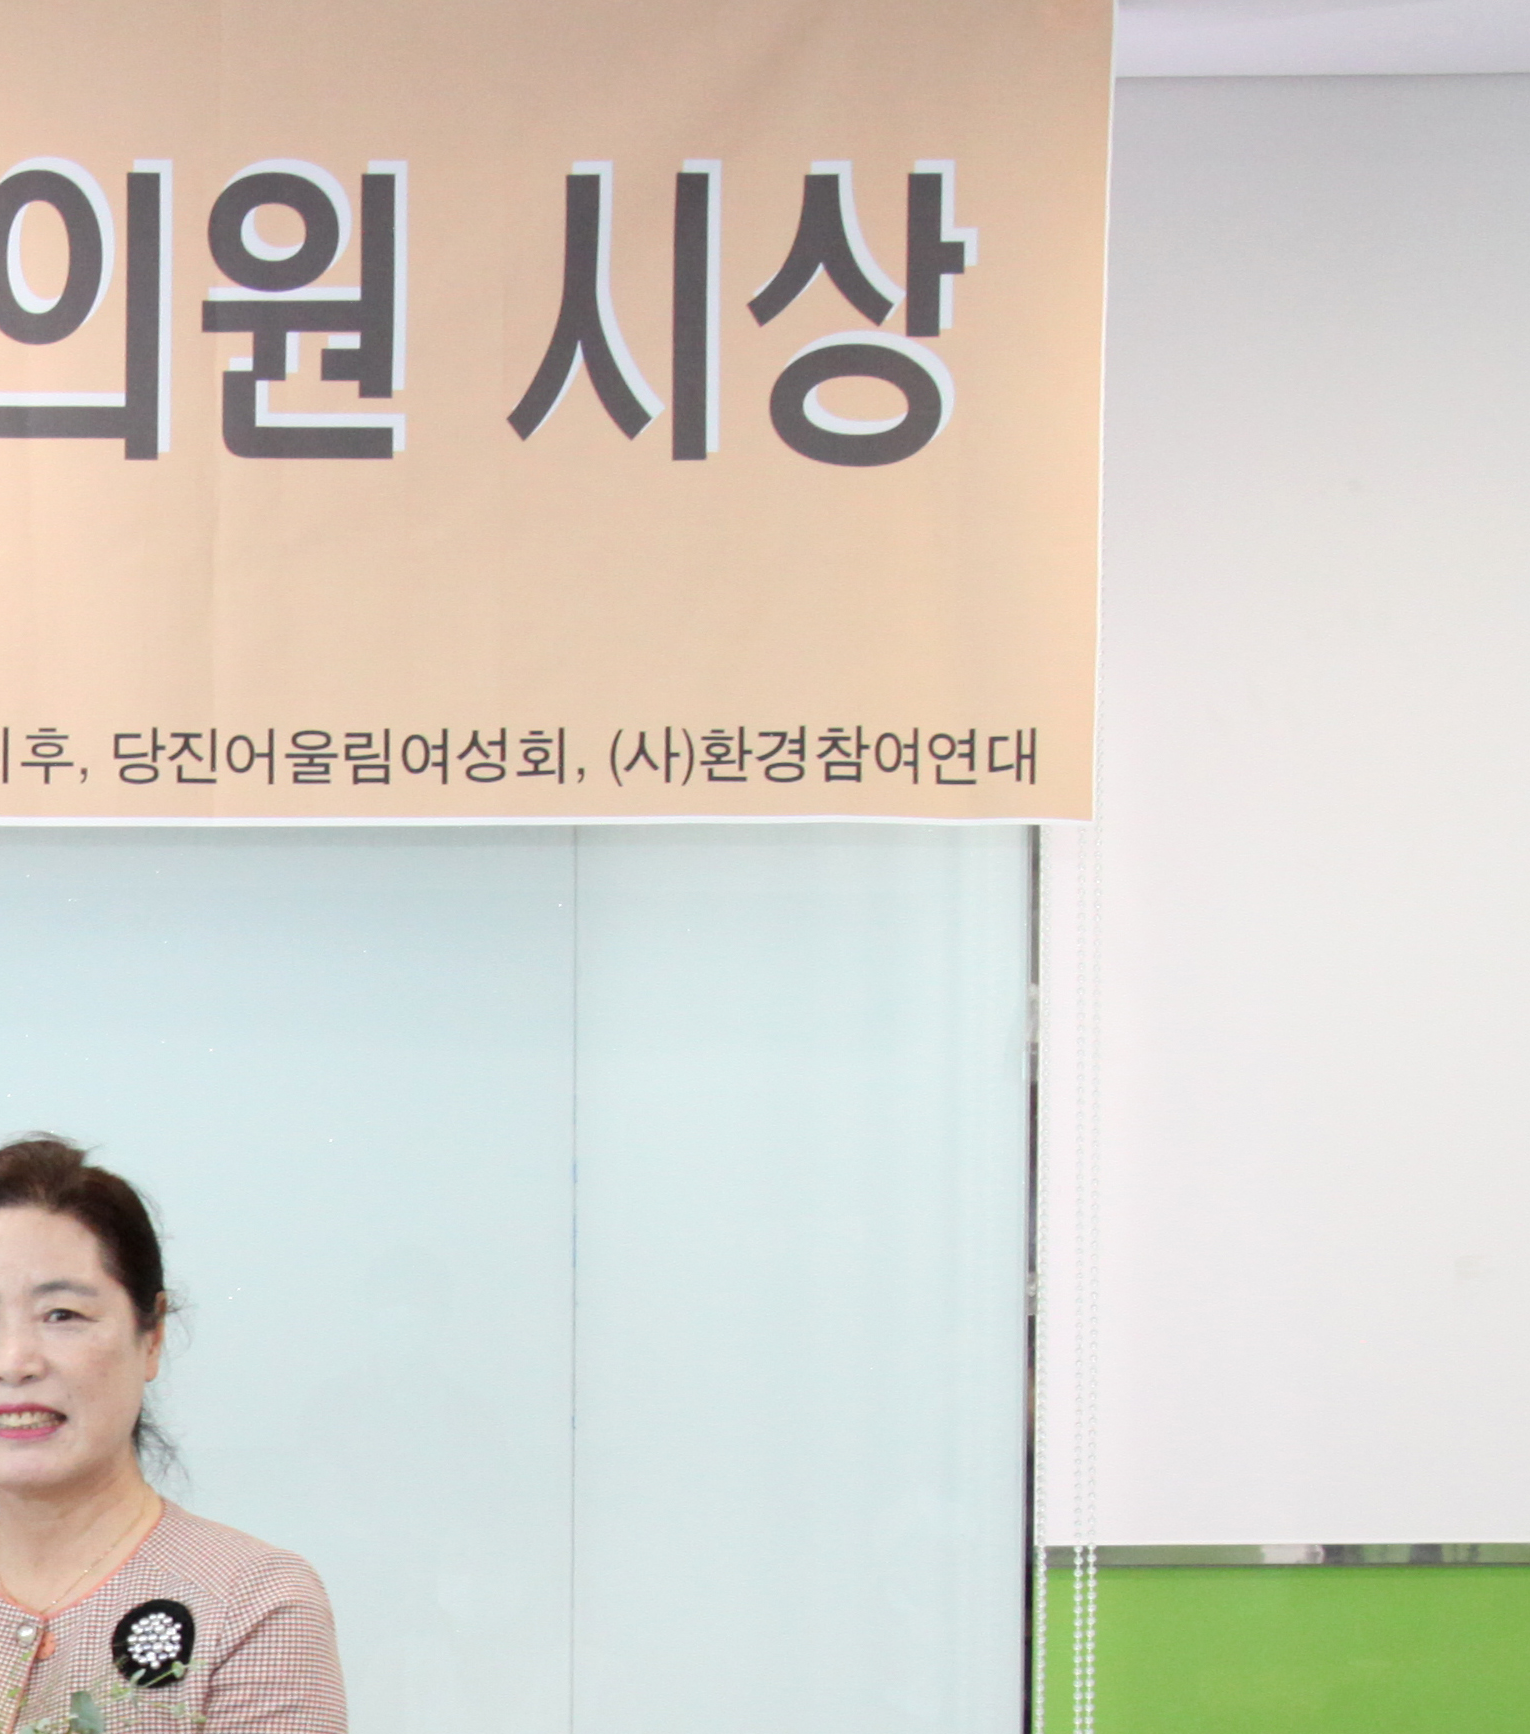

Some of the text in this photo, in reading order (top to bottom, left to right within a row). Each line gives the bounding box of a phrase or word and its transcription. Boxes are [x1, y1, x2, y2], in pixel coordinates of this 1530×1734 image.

[506, 169, 966, 467] 시상
[114, 727, 585, 785] 당진어울림여성회,
[610, 725, 1037, 787] (사)환경참여연대
